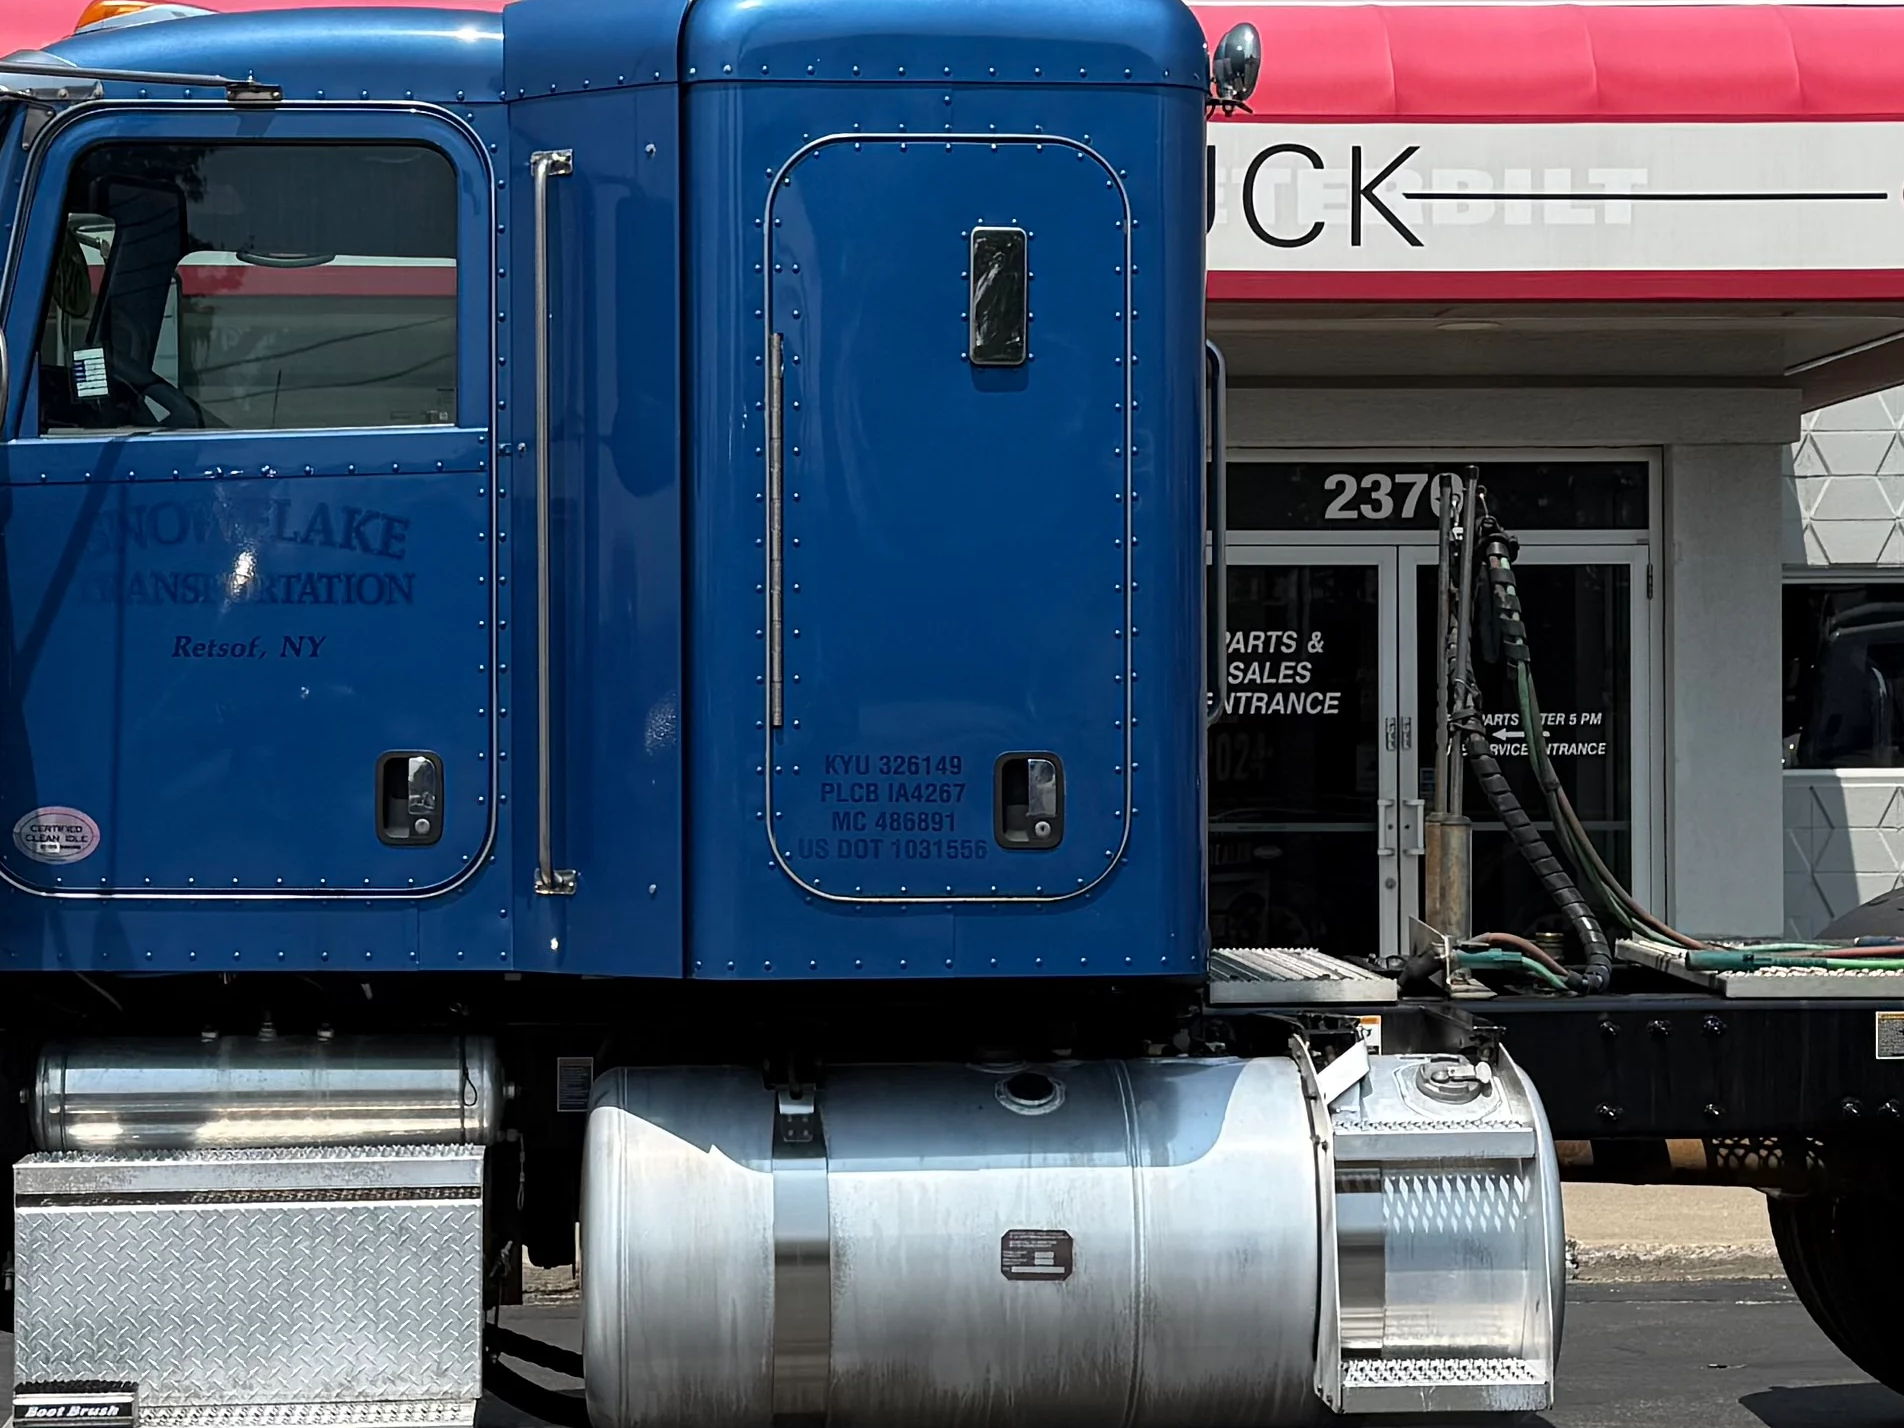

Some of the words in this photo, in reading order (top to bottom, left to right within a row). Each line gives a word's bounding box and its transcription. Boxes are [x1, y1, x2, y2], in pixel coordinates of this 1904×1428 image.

[1207, 143, 1424, 248] CK
[86, 498, 410, 560] SNOLAKE
[171, 634, 267, 659] Retsof,
[279, 634, 327, 658] NY
[1307, 631, 1324, 653] &
[1228, 661, 1312, 684] SALES
[1482, 713, 1520, 726] ARTS
[1539, 712, 1565, 725] TER
[1569, 713, 1577, 725] 5
[1580, 712, 1602, 725] PM
[1490, 743, 1529, 756] RVICE
[1546, 742, 1607, 755] NTRANCE
[825, 754, 870, 776] KYU
[879, 754, 963, 776] 326149
[820, 782, 880, 803] PLCB
[887, 782, 967, 803] IA4267
[831, 810, 867, 832] MC
[875, 810, 955, 832] 486891
[25, 834, 60, 843] CLEAN
[798, 837, 830, 859] US
[837, 837, 884, 859] DOT
[891, 837, 989, 860] 1031556
[24, 1406, 66, 1418] Boot
[66, 1405, 120, 1417] Brush
